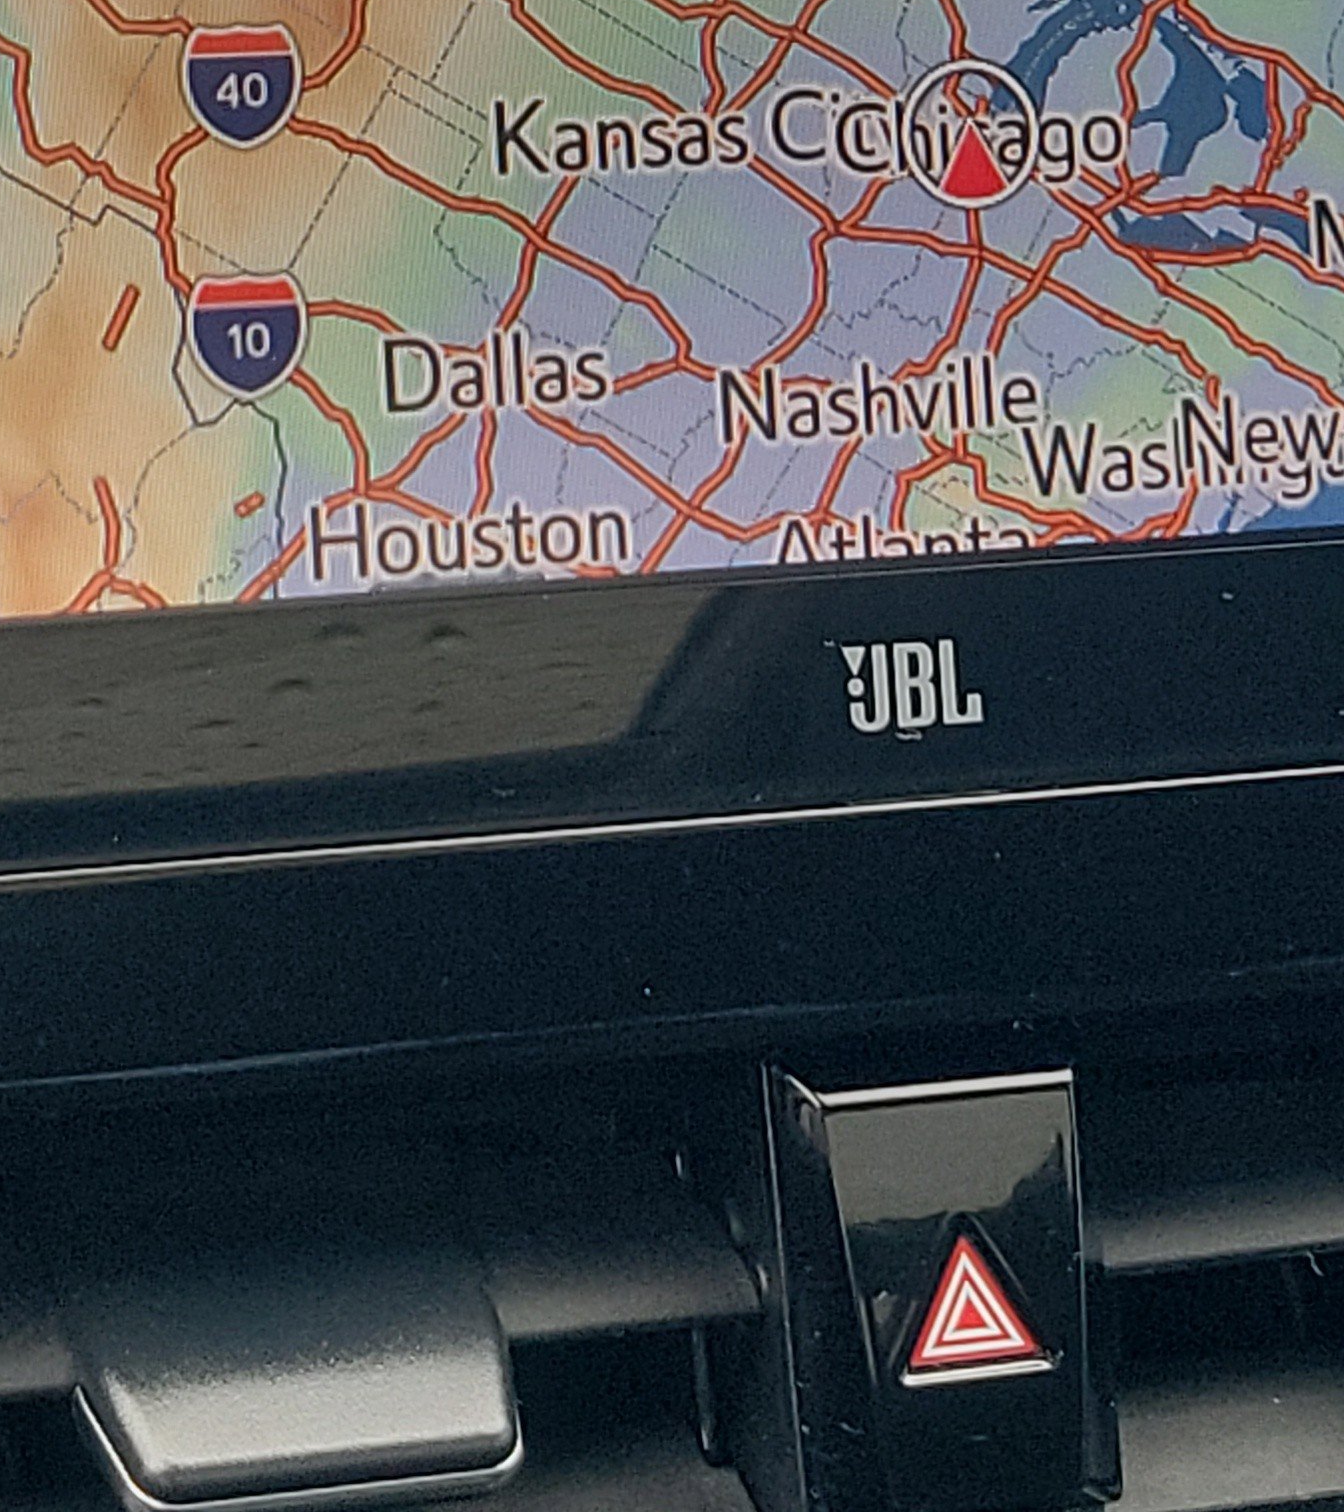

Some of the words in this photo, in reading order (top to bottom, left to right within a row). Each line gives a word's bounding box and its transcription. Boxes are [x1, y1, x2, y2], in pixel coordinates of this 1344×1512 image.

[215, 71, 269, 111] 40
[491, 98, 749, 176] Kansas
[835, 97, 1124, 183] Chiago
[225, 321, 271, 361] 10
[384, 330, 609, 413] Dallas
[717, 354, 1038, 444] Nashville
[1181, 393, 1342, 470] New
[310, 500, 629, 580] Houston
[842, 638, 984, 733] JBL
